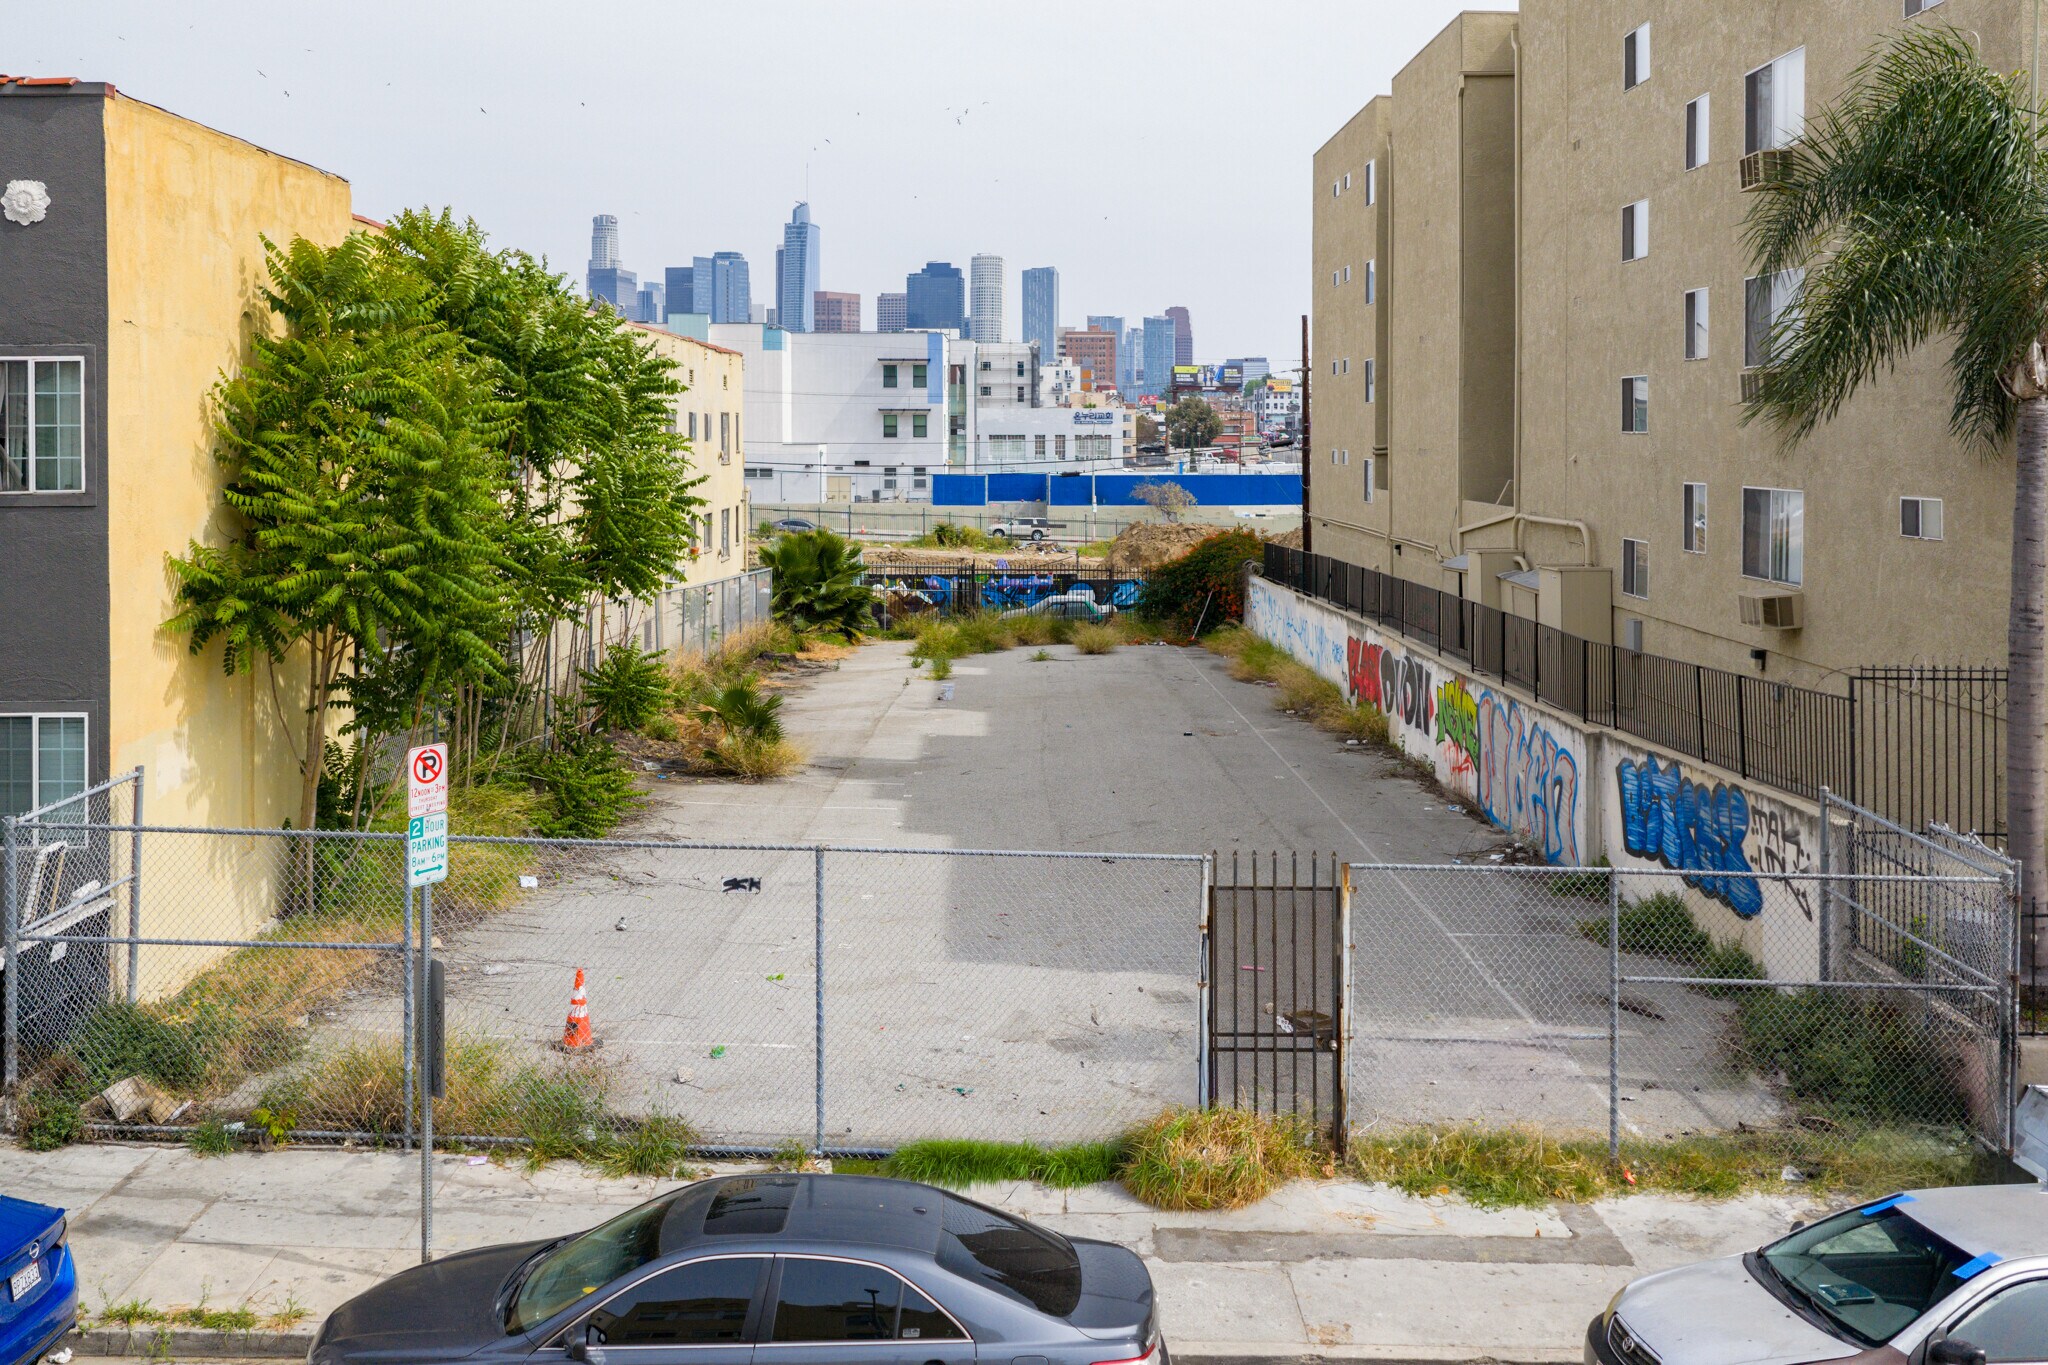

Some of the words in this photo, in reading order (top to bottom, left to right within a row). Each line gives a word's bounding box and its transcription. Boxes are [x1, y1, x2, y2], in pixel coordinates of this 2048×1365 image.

[1074, 411, 1113, 420] 온누리교회
[434, 784, 446, 793] 3PM
[412, 821, 421, 836] 2
[425, 819, 444, 833] HOUR
[412, 834, 445, 853] PARKING
[412, 856, 426, 868] 8AM
[431, 852, 445, 863] 6PM
